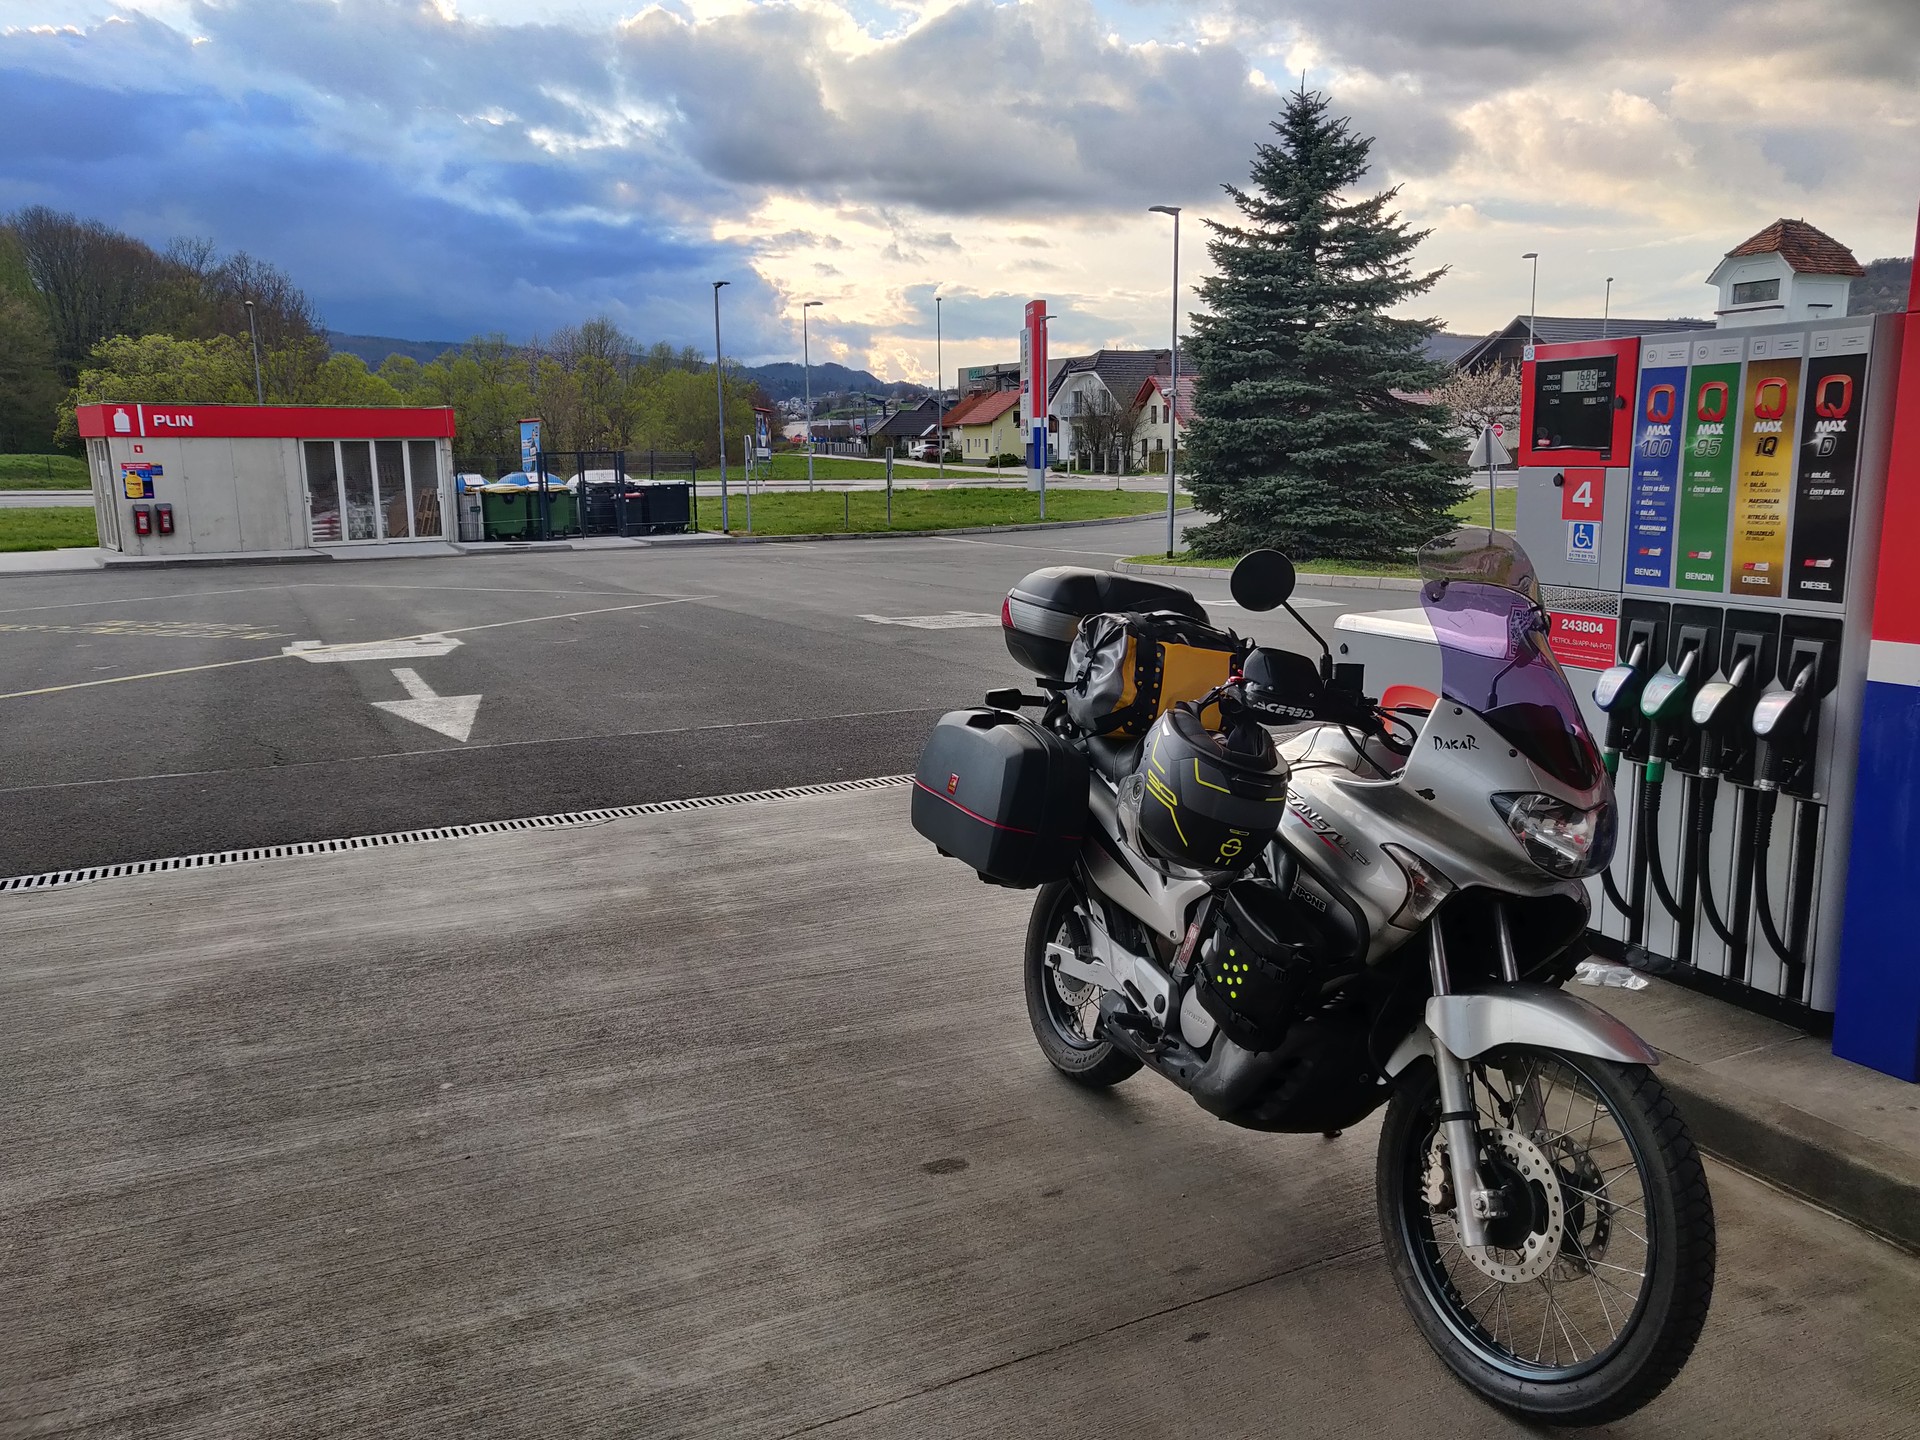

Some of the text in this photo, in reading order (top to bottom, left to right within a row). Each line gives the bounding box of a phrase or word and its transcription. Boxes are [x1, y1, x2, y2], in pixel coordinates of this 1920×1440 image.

[1646, 384, 1676, 424] Q
[1697, 381, 1729, 423] Q
[1754, 377, 1788, 421] Q
[1816, 374, 1853, 419] Q
[153, 414, 193, 427] PLIN
[1697, 423, 1724, 435] MAX
[1753, 420, 1783, 433] MAX
[1814, 420, 1848, 433] MAX
[1646, 424, 1672, 436] MAX
[1641, 438, 1672, 458] 100
[1694, 438, 1722, 458] 95
[1756, 436, 1778, 457] iQ
[1816, 435, 1837, 457] D
[1572, 481, 1593, 508] 4
[1634, 568, 1661, 577] BENCIN
[1685, 572, 1714, 581] BENCIN
[1742, 576, 1770, 585] DIESEL
[1800, 581, 1832, 591] DIESEL
[1561, 619, 1603, 634] 243804
[1253, 702, 1314, 719] ACERBIS
[1433, 735, 1480, 751] DAKAR
[1287, 787, 1371, 866] RANSALP
[1294, 883, 1327, 912] IPONE
